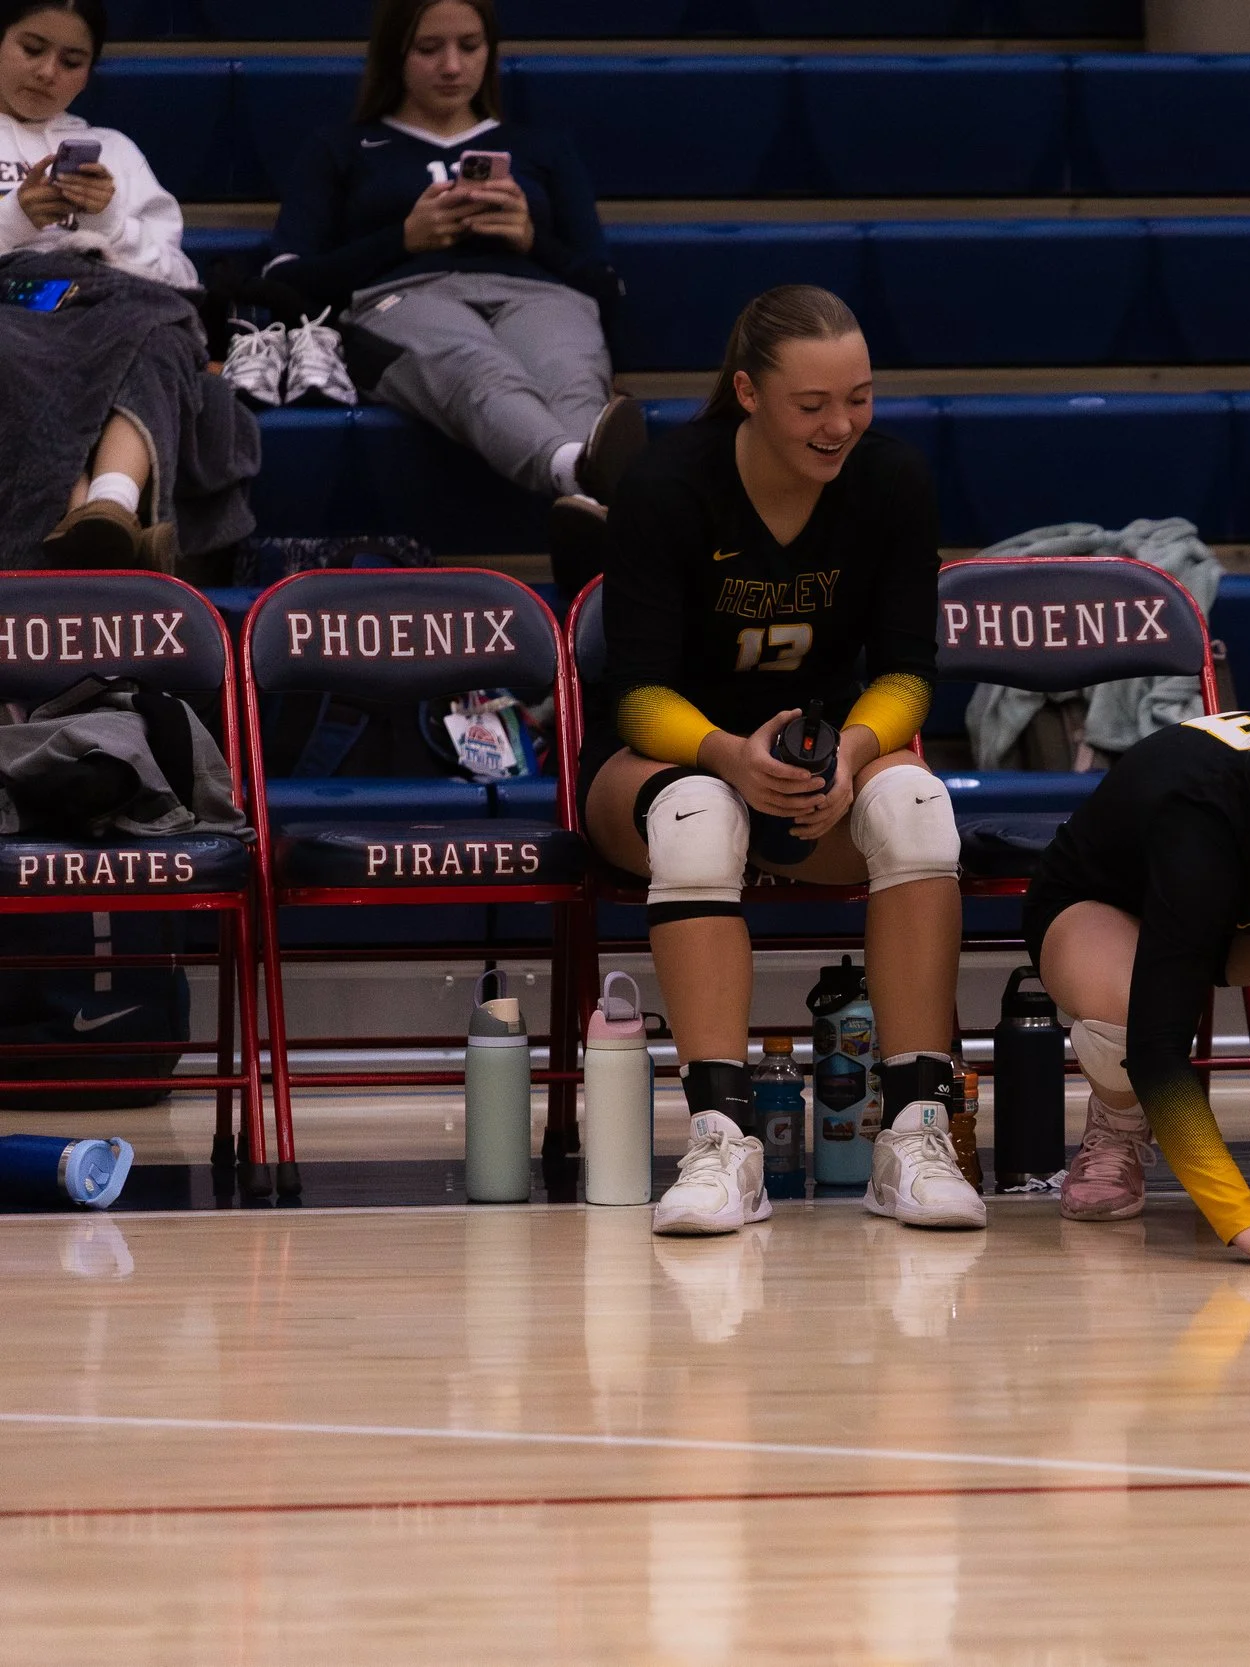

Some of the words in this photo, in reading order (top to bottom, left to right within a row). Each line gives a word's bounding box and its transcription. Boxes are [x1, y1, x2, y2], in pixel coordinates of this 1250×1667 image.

[714, 569, 840, 619] HENLEY
[0, 612, 185, 660] HOENIX
[288, 610, 515, 657] PHOENIX
[944, 600, 1168, 647] PHOENIX
[18, 852, 194, 886] PIRATES
[367, 843, 540, 876] PIRATES
[766, 1116, 792, 1147] G
